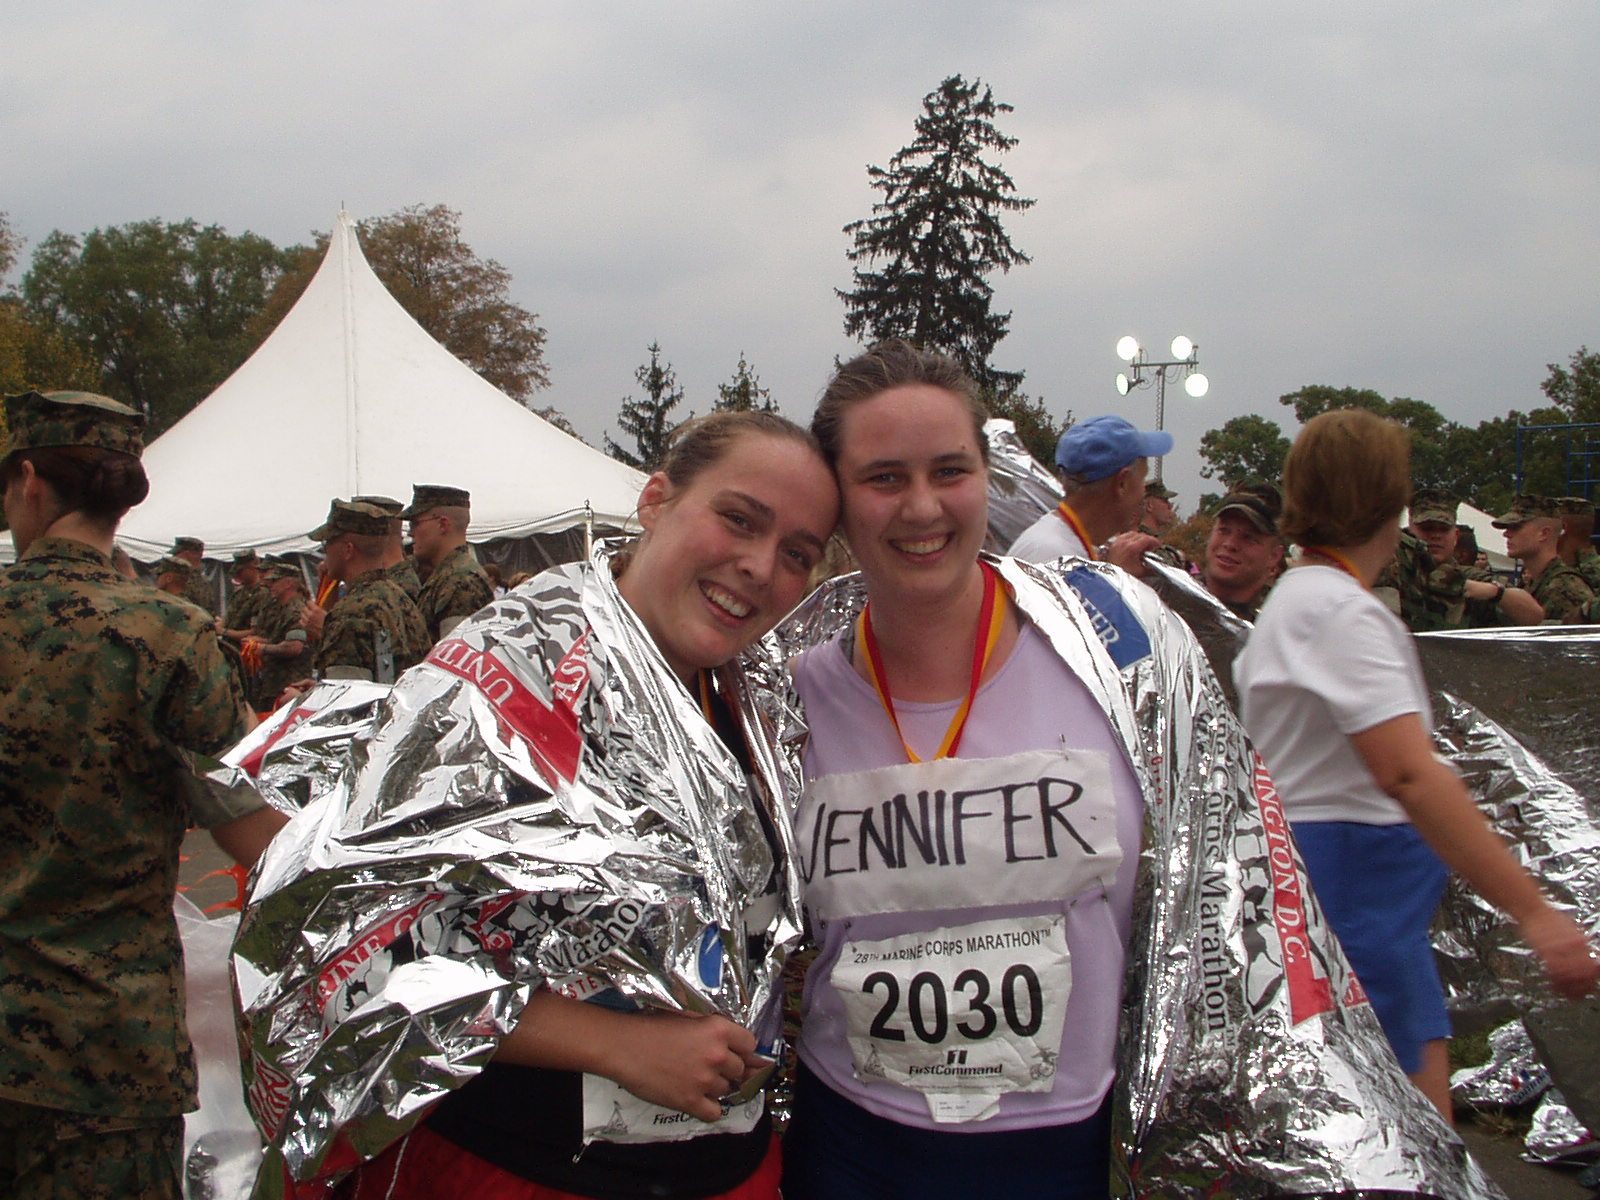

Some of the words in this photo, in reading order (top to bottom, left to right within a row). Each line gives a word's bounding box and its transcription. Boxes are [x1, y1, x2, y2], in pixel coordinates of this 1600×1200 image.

[800, 776, 1097, 884] JENNIFER
[882, 944, 923, 961] MARINE
[925, 938, 964, 957] CORPS
[1276, 902, 1310, 965] D.C.
[862, 963, 1044, 1044] 2030
[908, 1063, 1003, 1077] FirstCommand
